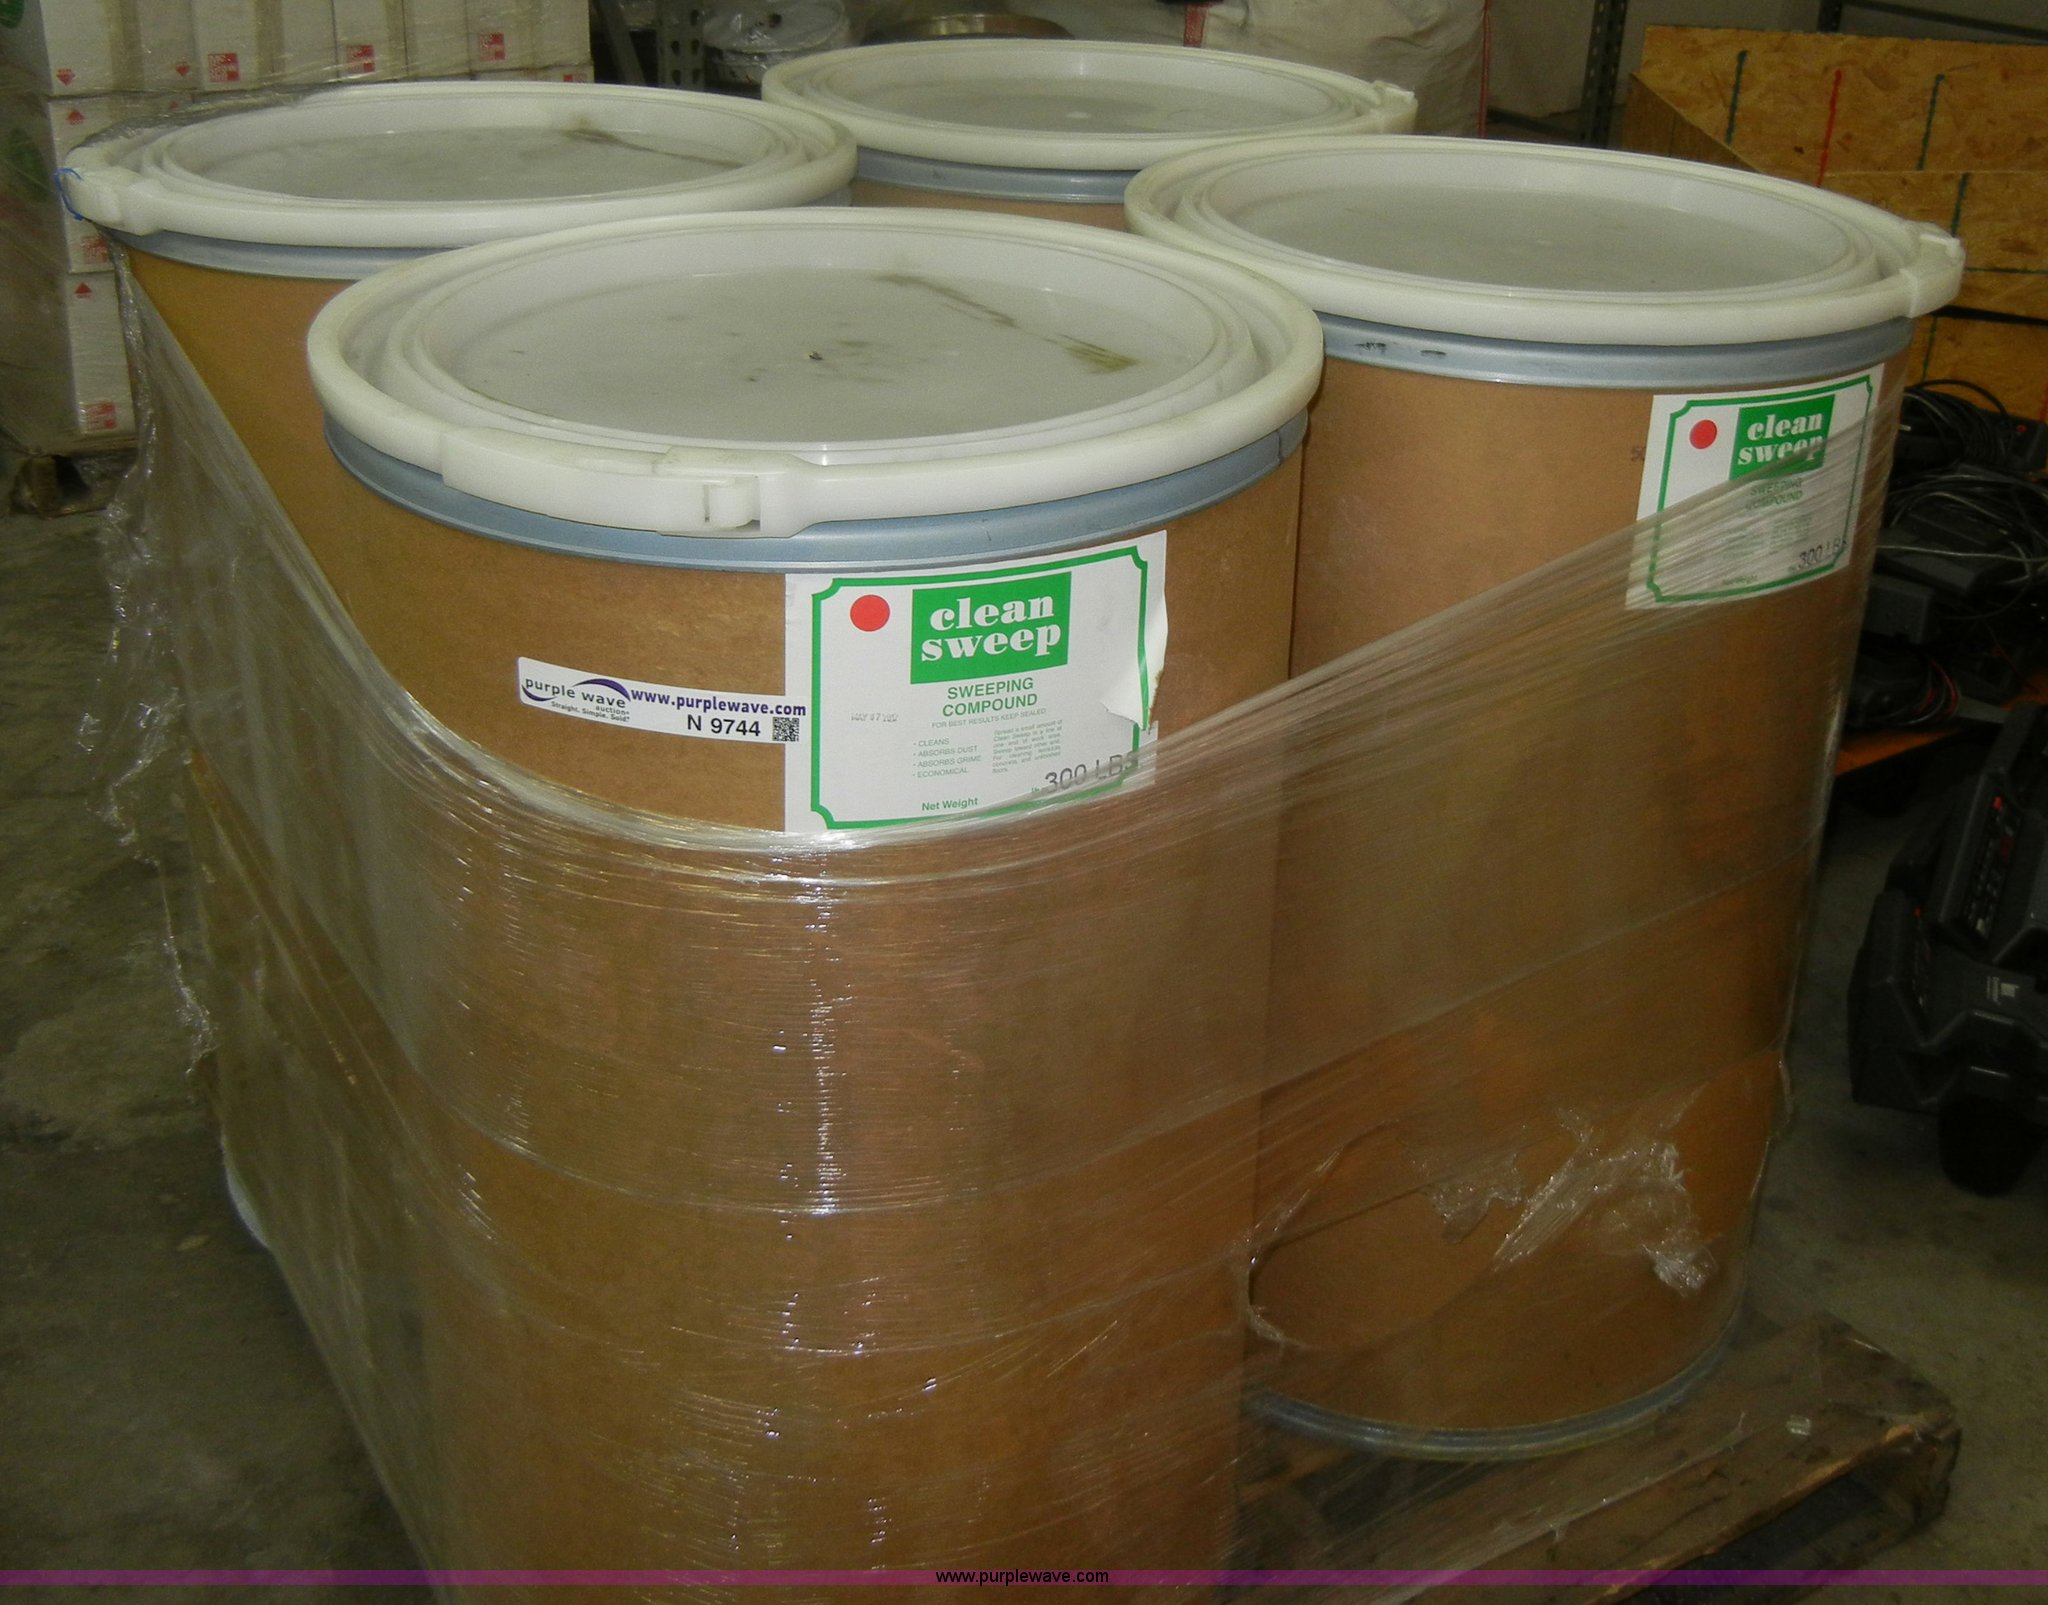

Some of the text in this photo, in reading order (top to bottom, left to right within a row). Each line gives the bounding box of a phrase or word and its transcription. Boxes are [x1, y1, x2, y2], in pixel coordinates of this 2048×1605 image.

[1747, 413, 1823, 441] clean
[930, 595, 1055, 631] clean
[921, 622, 1062, 662] sweep
[525, 678, 626, 709] purple wave
[947, 677, 1034, 700] SWEEPING
[631, 689, 806, 717] www.purplewave.com
[942, 693, 1038, 717] COMPOUND
[687, 714, 761, 737] N 9744
[931, 707, 1047, 729] FOR BEST RESULTS KEEP SEALED
[918, 737, 950, 748] CLEANS
[918, 745, 978, 758] ABSORBS DUST
[917, 767, 969, 779] ECONOMICAL
[918, 755, 982, 769] ABSORBS GRIME
[1045, 763, 1088, 794] 300
[922, 797, 978, 811] Net Weight
